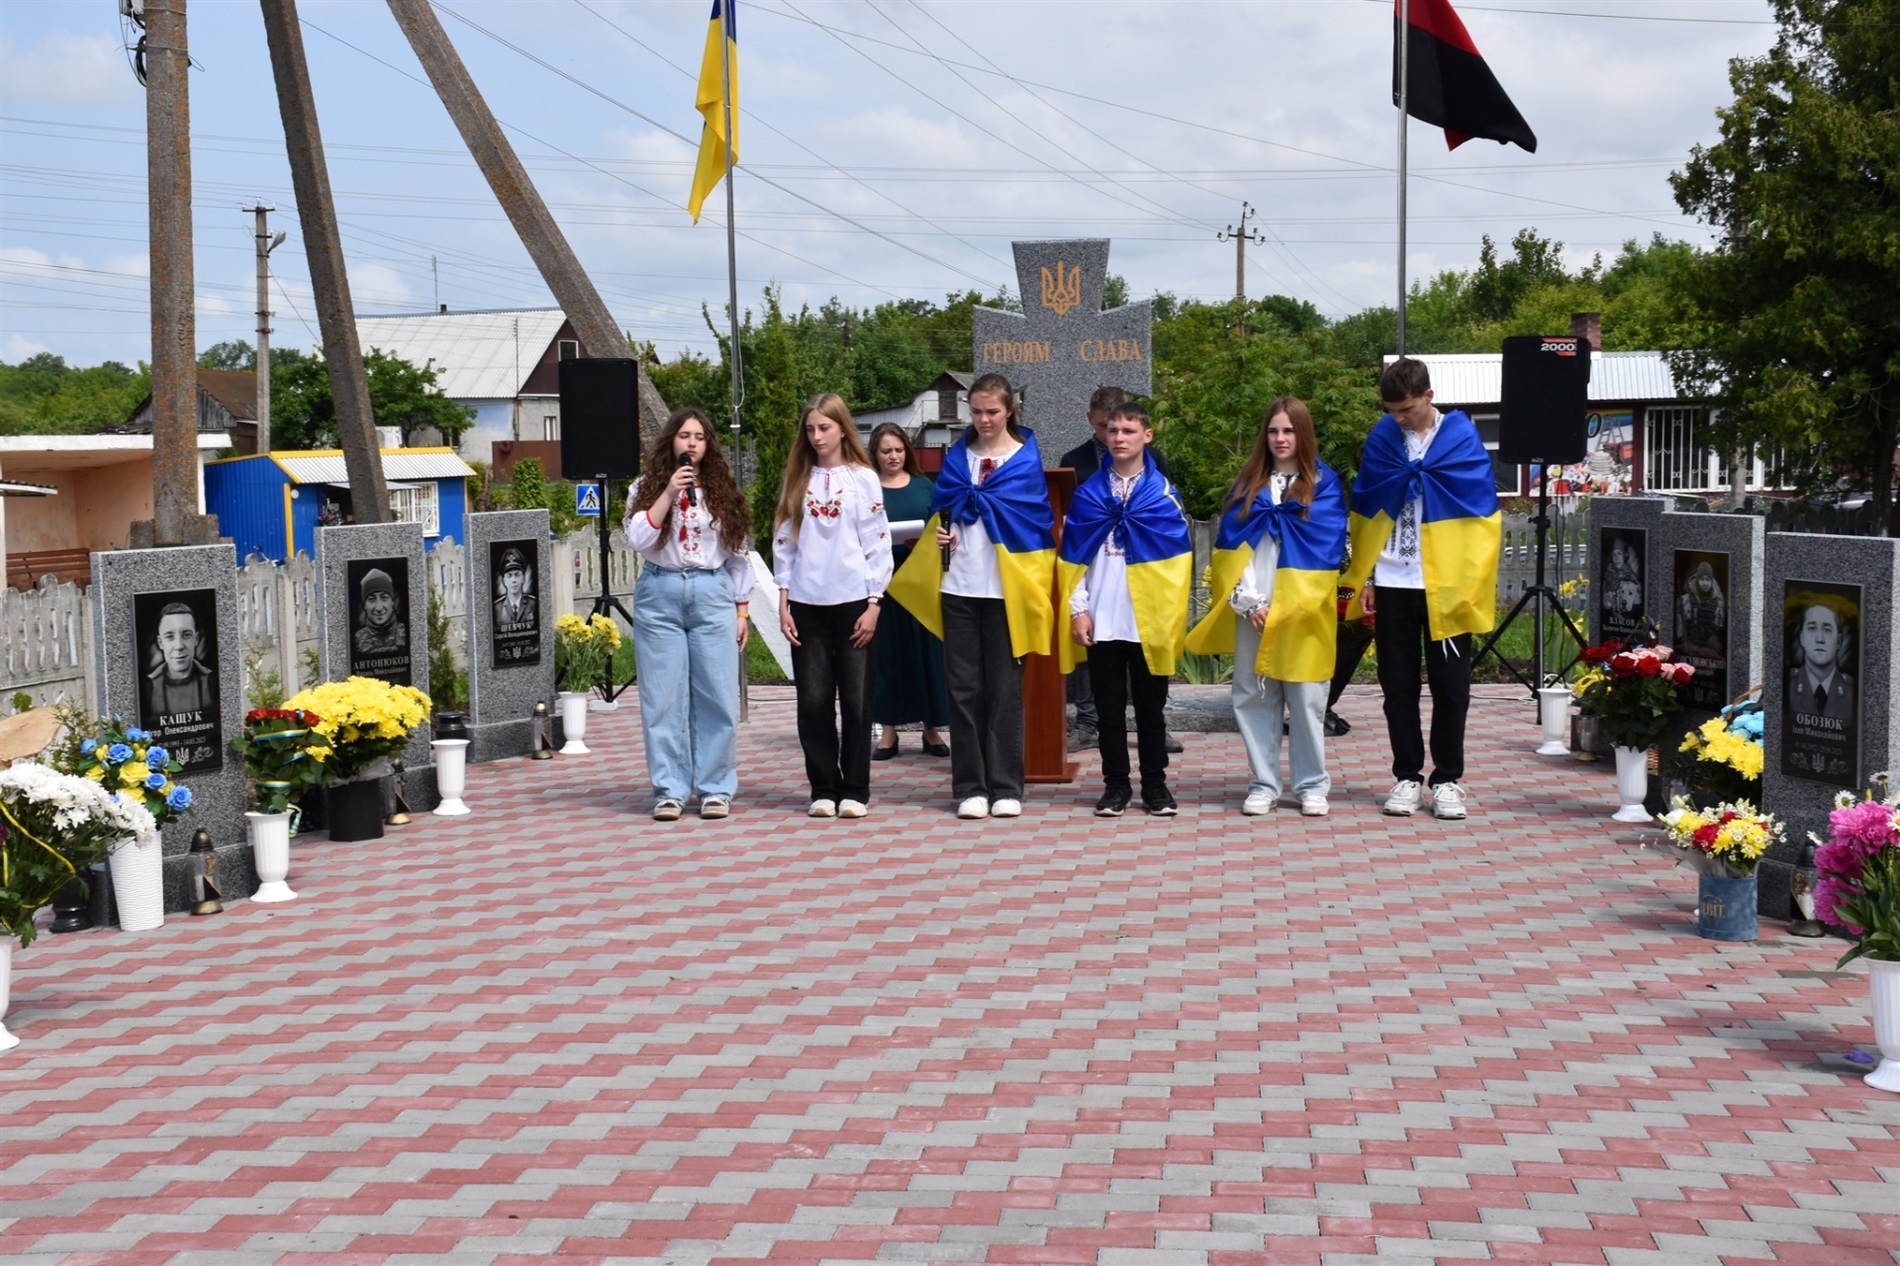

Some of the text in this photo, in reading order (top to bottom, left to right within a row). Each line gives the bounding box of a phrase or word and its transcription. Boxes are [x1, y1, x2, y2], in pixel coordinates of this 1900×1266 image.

[982, 338, 1142, 364] ГЕРОЯМ СЛАВА
[1541, 343, 1575, 351] 2000
[501, 621, 533, 632] ШЕВЧУК
[354, 656, 410, 670] АНТОНЮКОВ
[160, 711, 202, 726] КАЩУК
[1796, 713, 1843, 730] ОБОЗЮК
